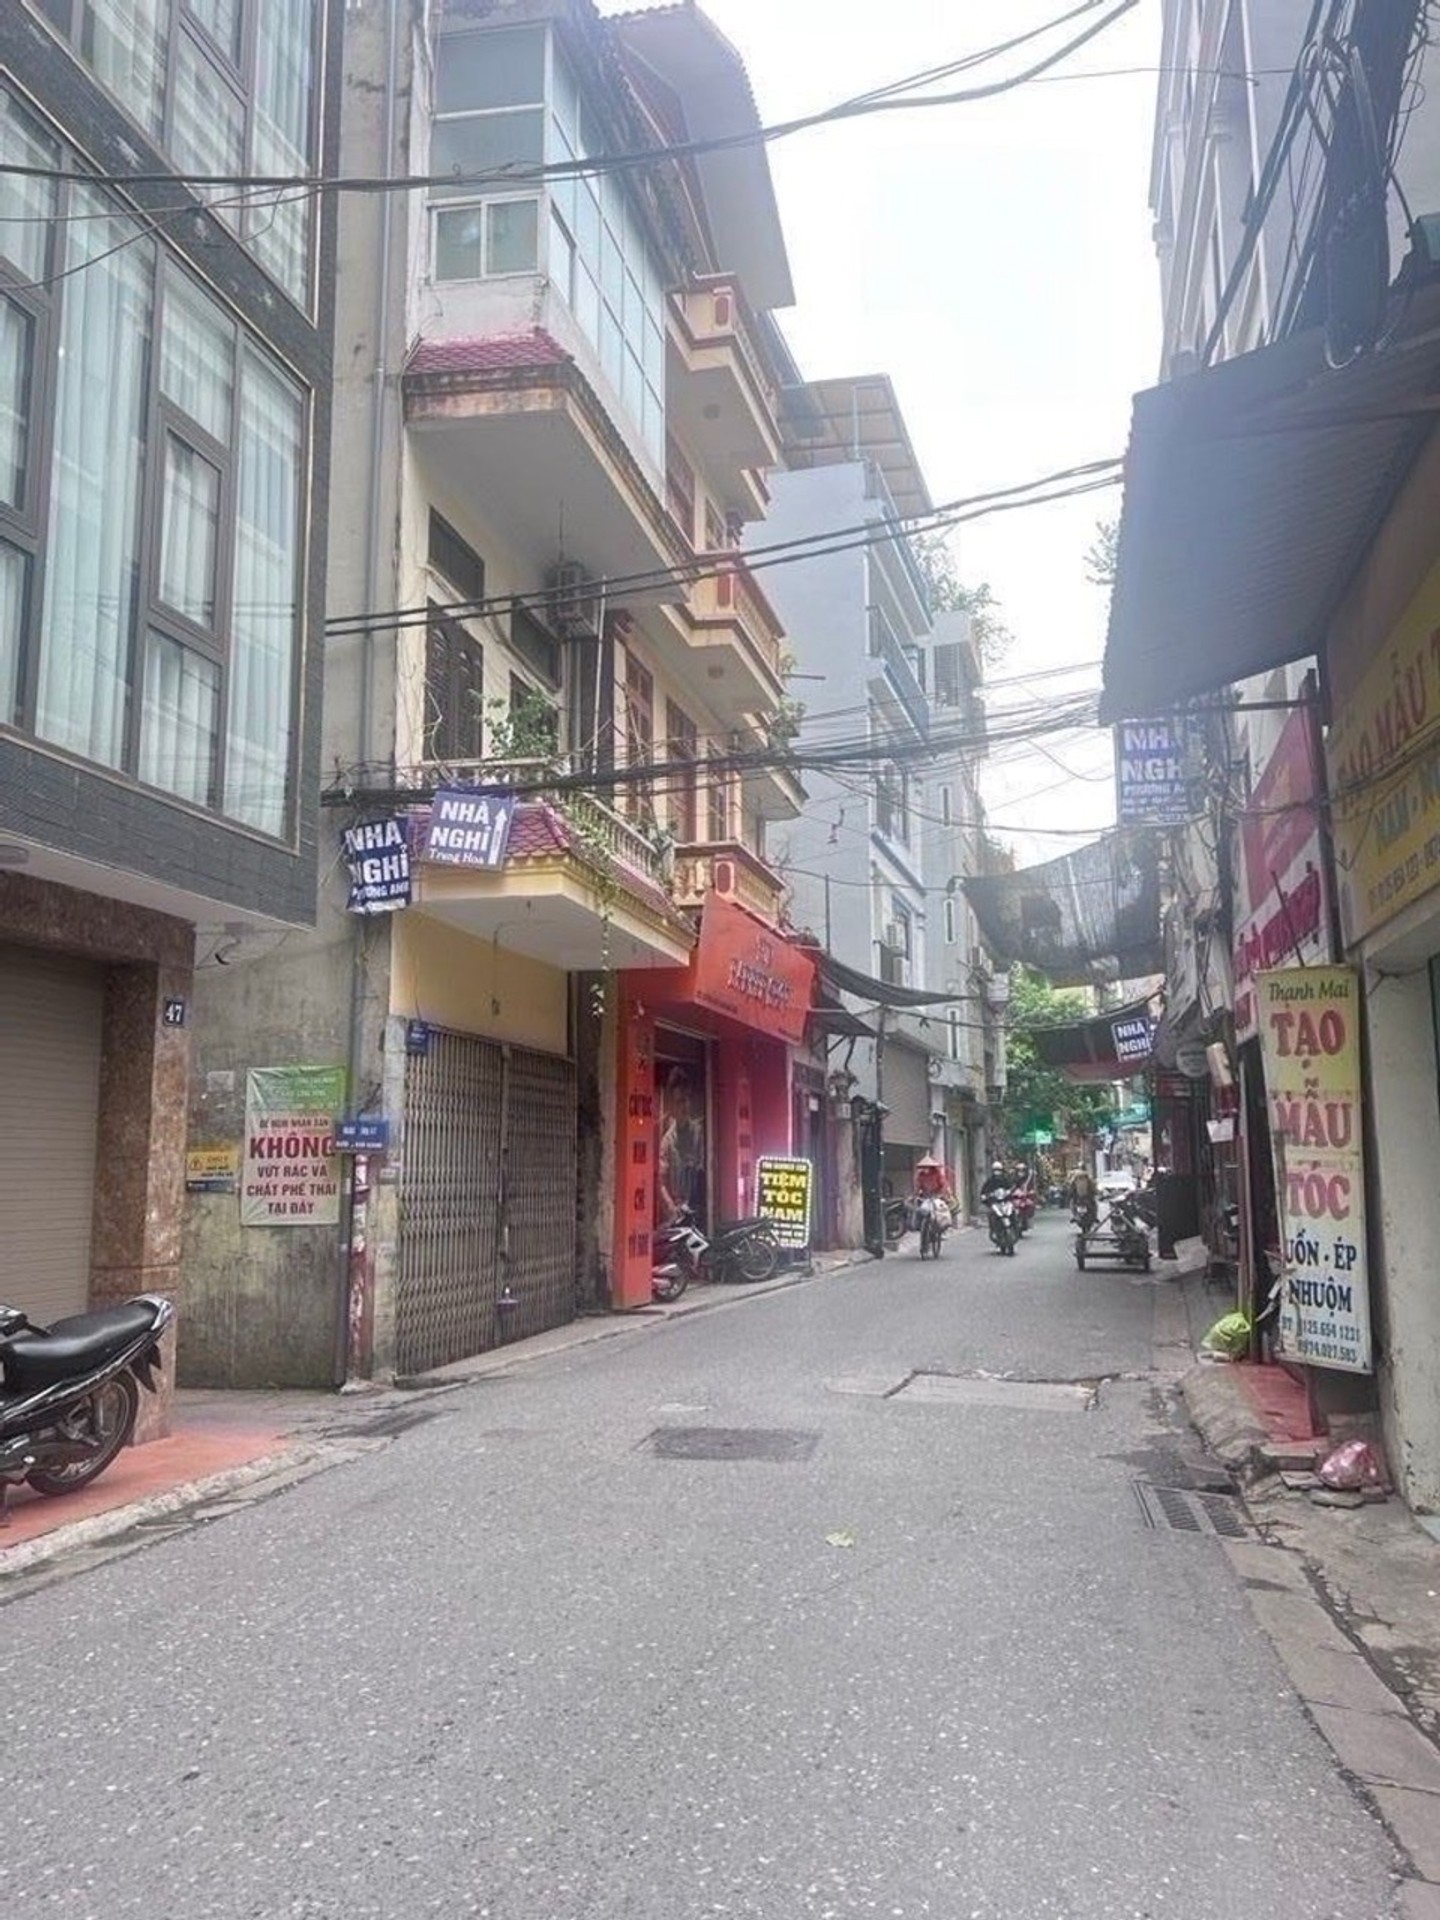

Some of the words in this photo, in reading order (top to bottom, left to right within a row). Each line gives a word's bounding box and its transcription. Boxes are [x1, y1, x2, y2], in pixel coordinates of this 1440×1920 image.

[440, 800, 489, 825] NHÀ
[166, 1004, 183, 1023] 47
[1270, 1009, 1346, 1070] TẠO
[761, 1172, 807, 1189] TIỆM
[1287, 1160, 1350, 1221] TÓC
[760, 1206, 804, 1222] NAM
[1333, 1236, 1357, 1271] ÉP
